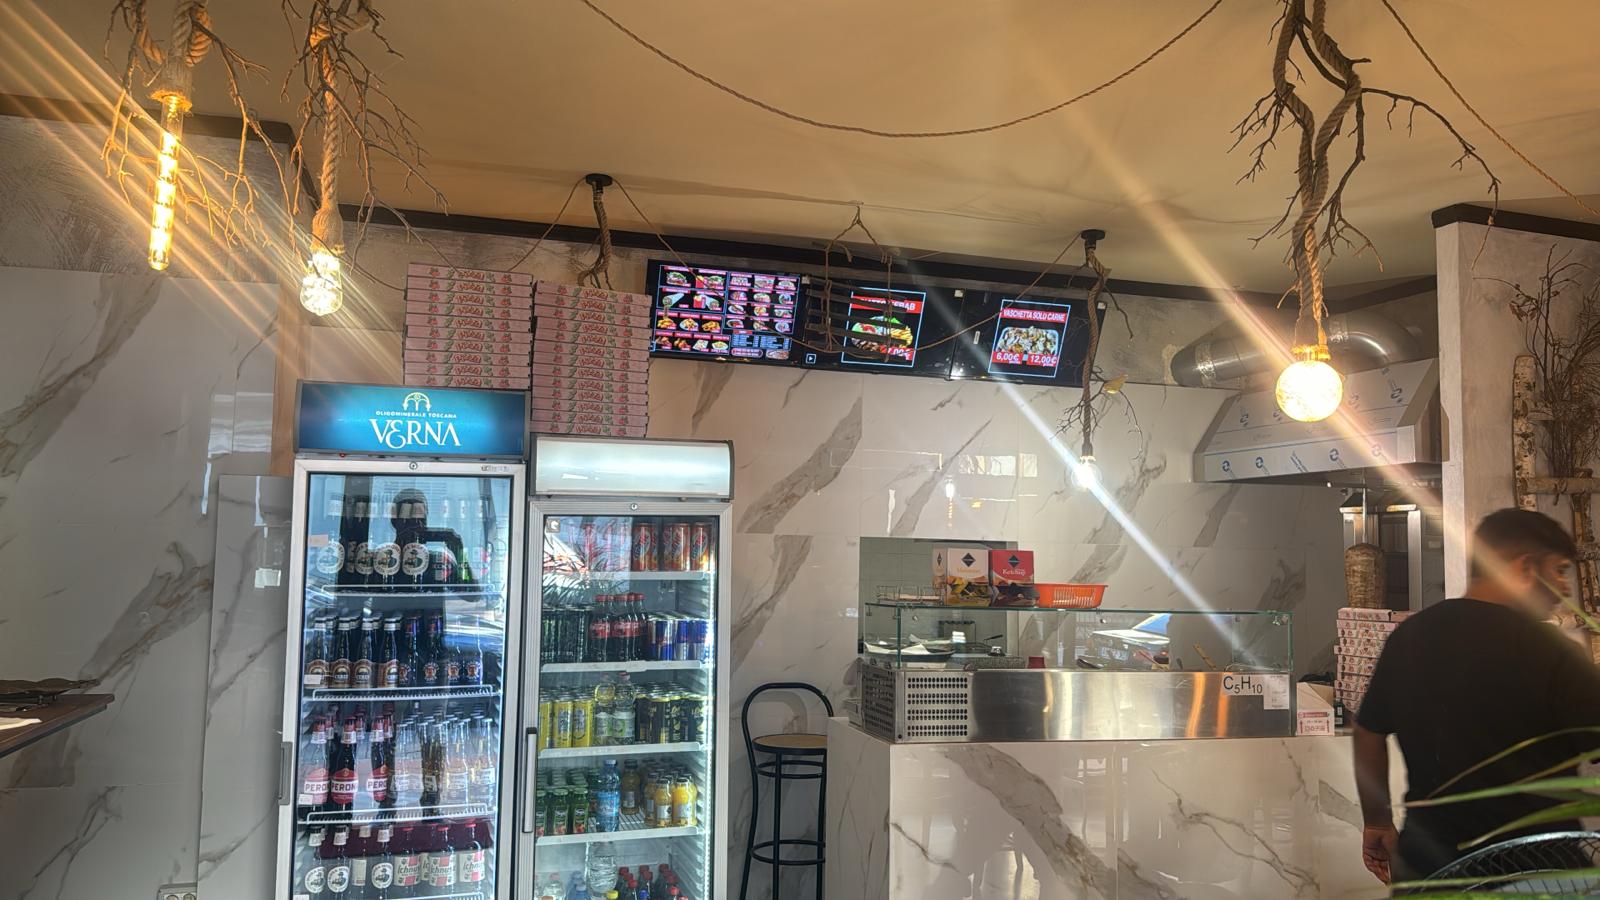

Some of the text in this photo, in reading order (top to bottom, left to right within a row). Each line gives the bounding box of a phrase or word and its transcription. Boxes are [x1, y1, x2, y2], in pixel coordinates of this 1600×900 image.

[1032, 311, 1048, 320] SOLO
[1048, 312, 1066, 322] CARNE
[375, 410, 426, 418] OLIGOMINERALE
[368, 418, 462, 449] VERNA
